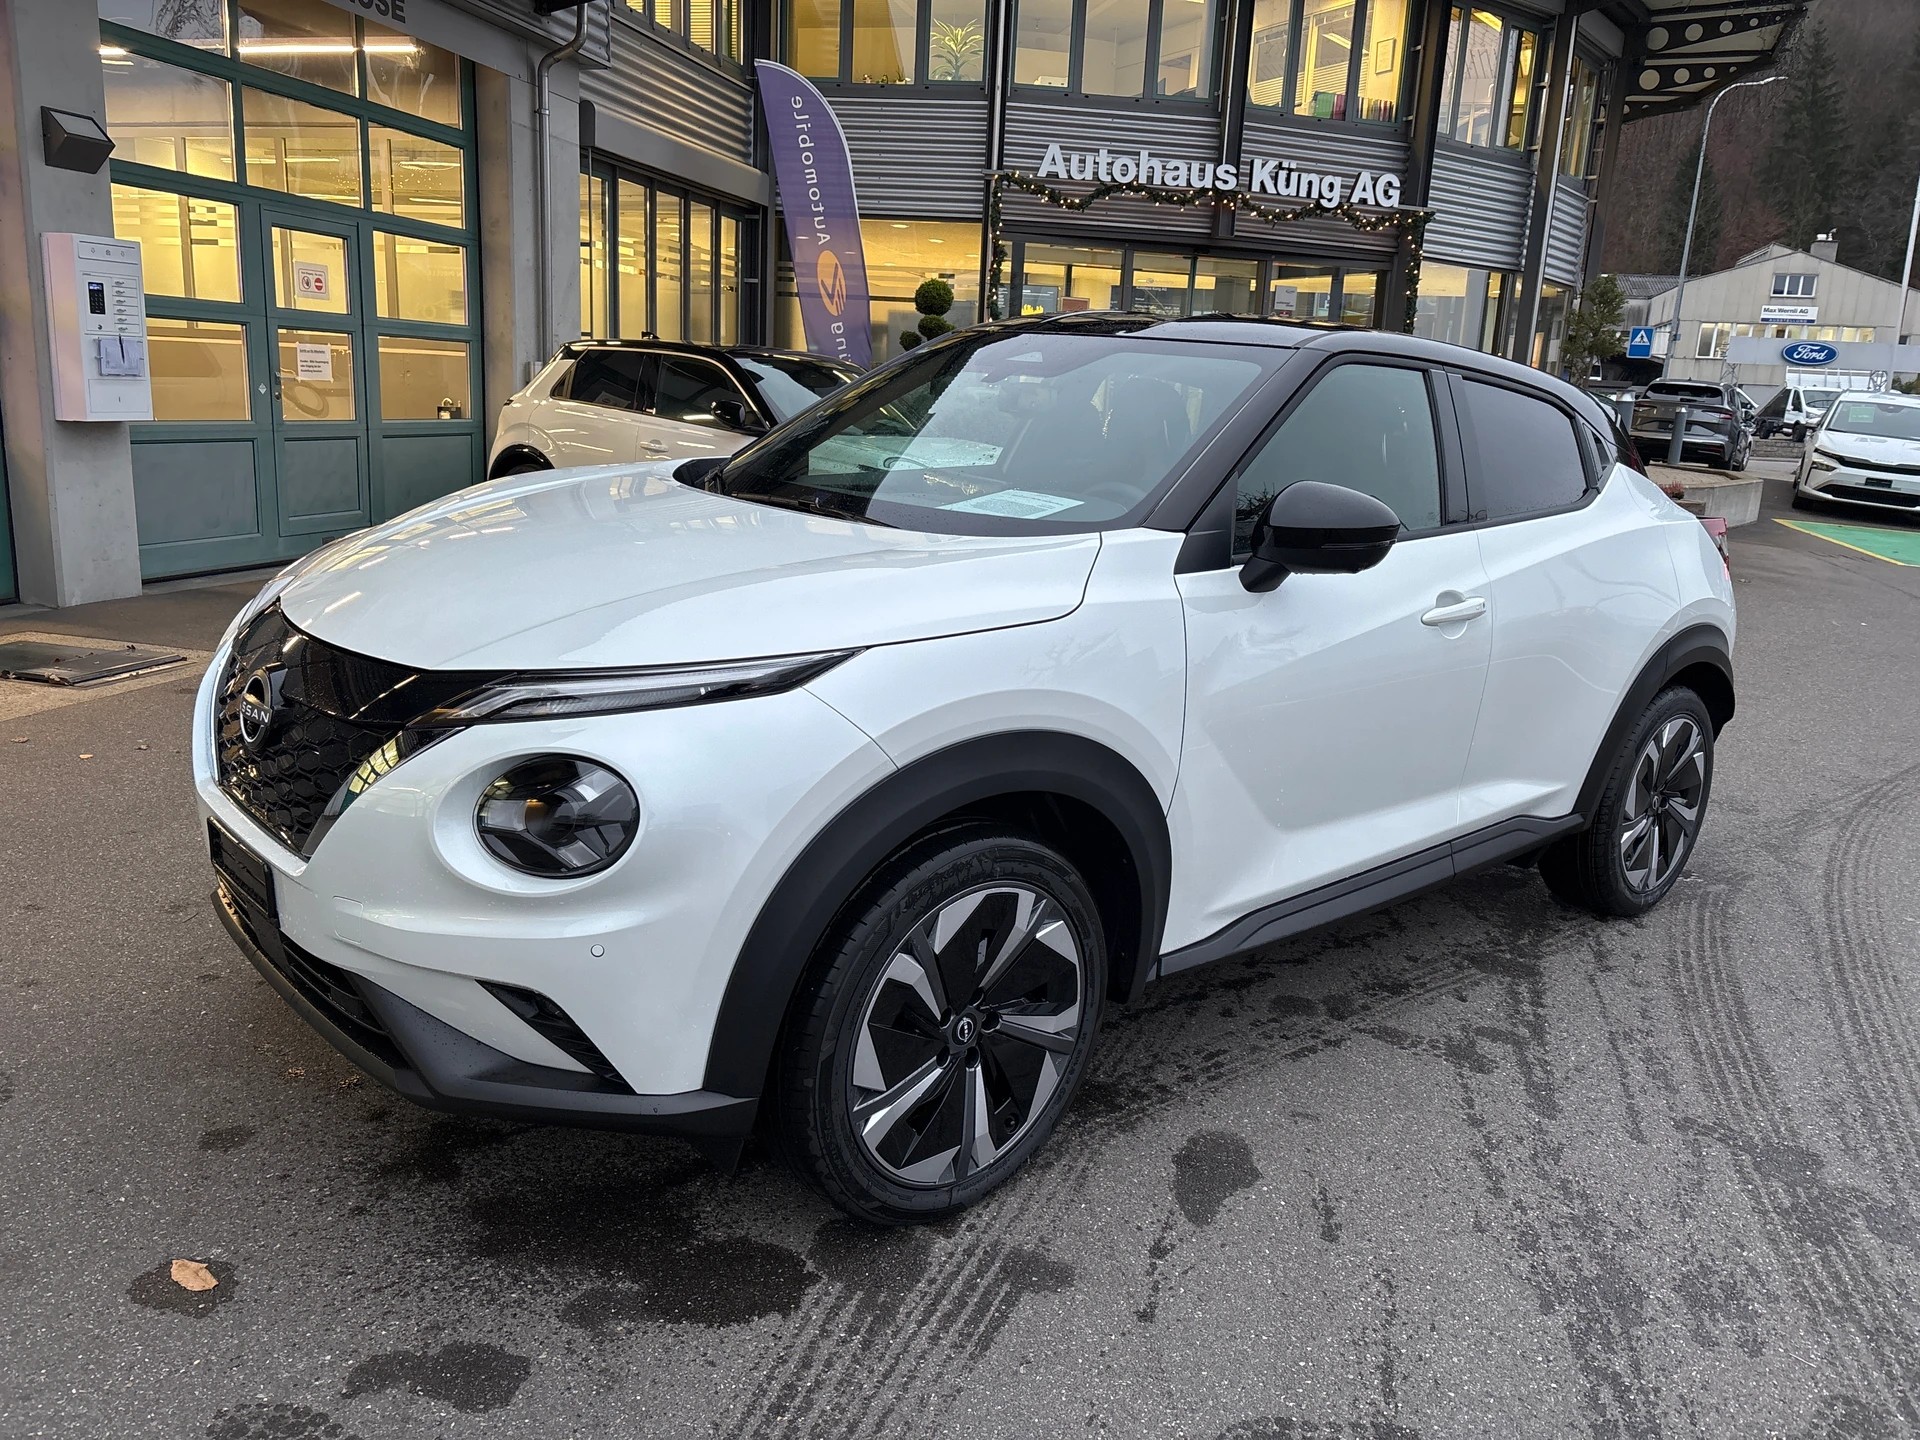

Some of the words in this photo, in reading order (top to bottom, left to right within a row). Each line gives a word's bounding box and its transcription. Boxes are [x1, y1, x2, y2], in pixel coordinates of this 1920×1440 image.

[1037, 143, 1238, 191] Autohaus
[1251, 158, 1342, 208] Küng
[1350, 171, 1401, 208] AG
[1793, 344, 1829, 360] Ford
[241, 701, 270, 723] SSAN
